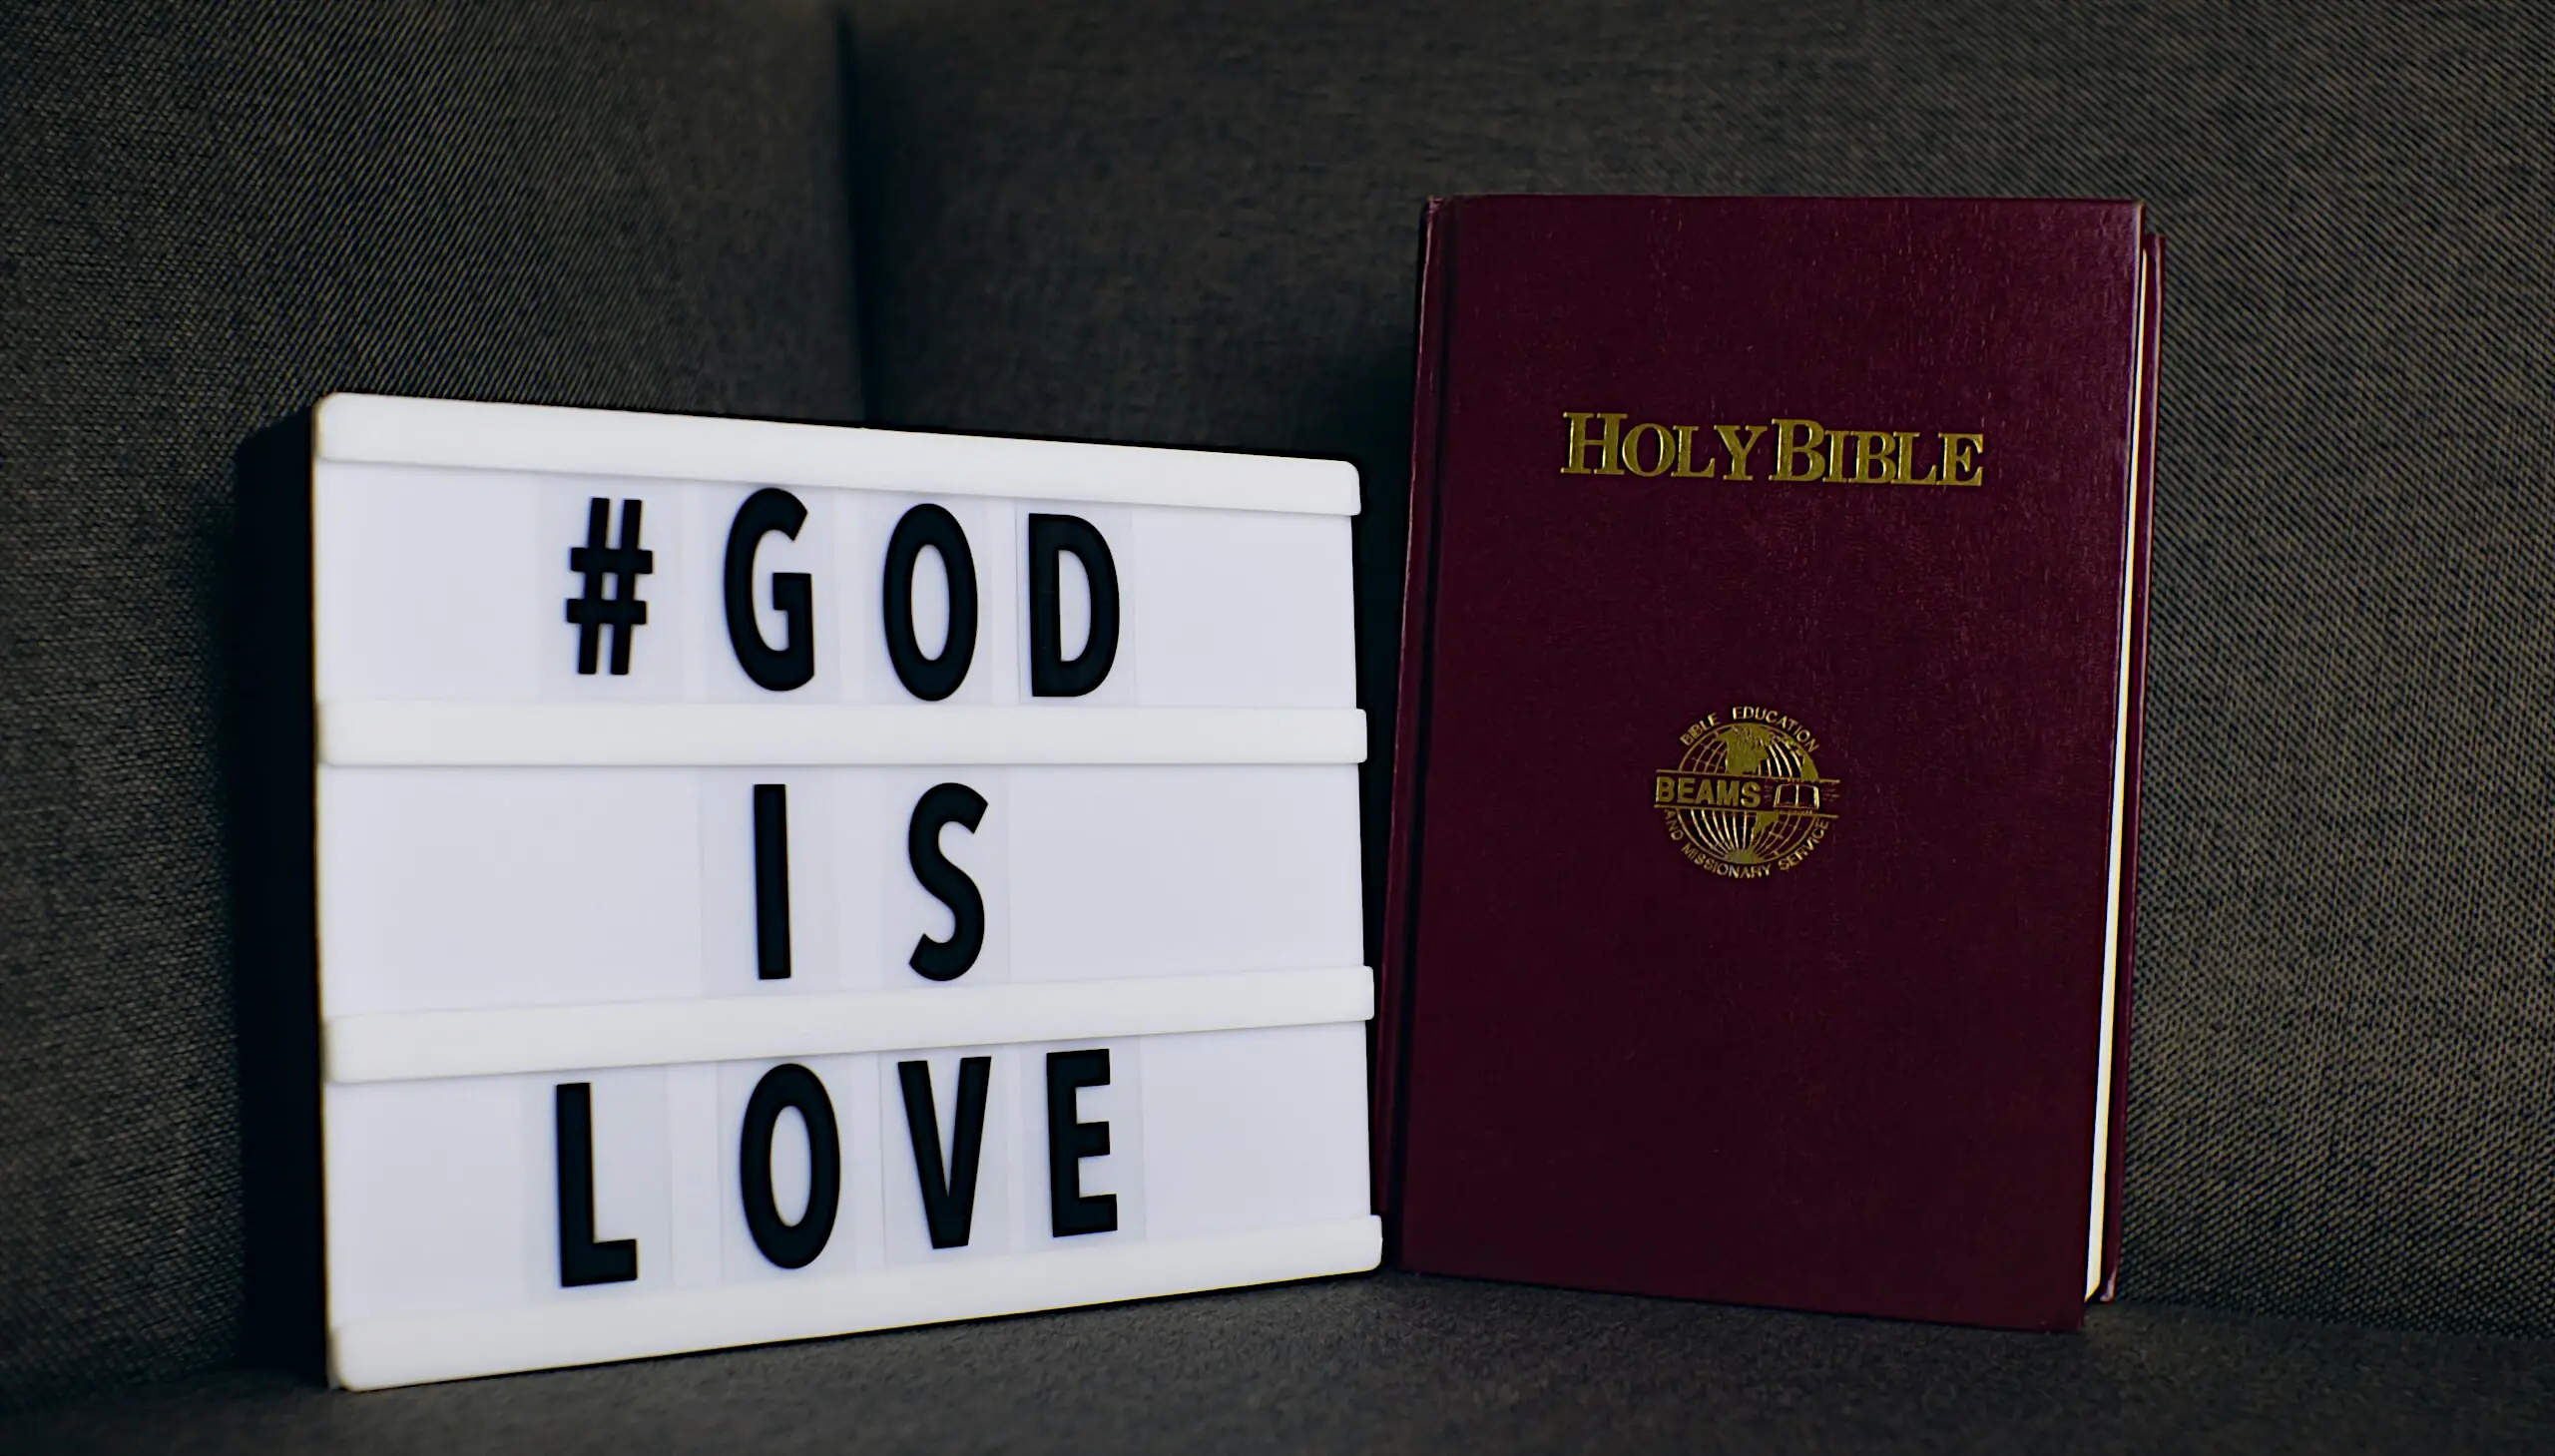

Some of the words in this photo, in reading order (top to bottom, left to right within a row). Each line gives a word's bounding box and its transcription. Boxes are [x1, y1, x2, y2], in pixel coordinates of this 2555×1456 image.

[1562, 411, 1769, 481] HOLY
[1772, 418, 1985, 488] BIBLE
[566, 487, 1122, 704] #GOD
[1680, 713, 1721, 746] BIBLE
[1733, 706, 1819, 752] EDUCATION
[1656, 776, 1763, 808] BEAMS
[753, 782, 989, 981] IS
[1664, 809, 1685, 841] AND
[1681, 845, 1772, 879] MISSIONARY
[1779, 819, 1829, 871] SERVICE
[554, 1048, 1119, 1288] LOVE
